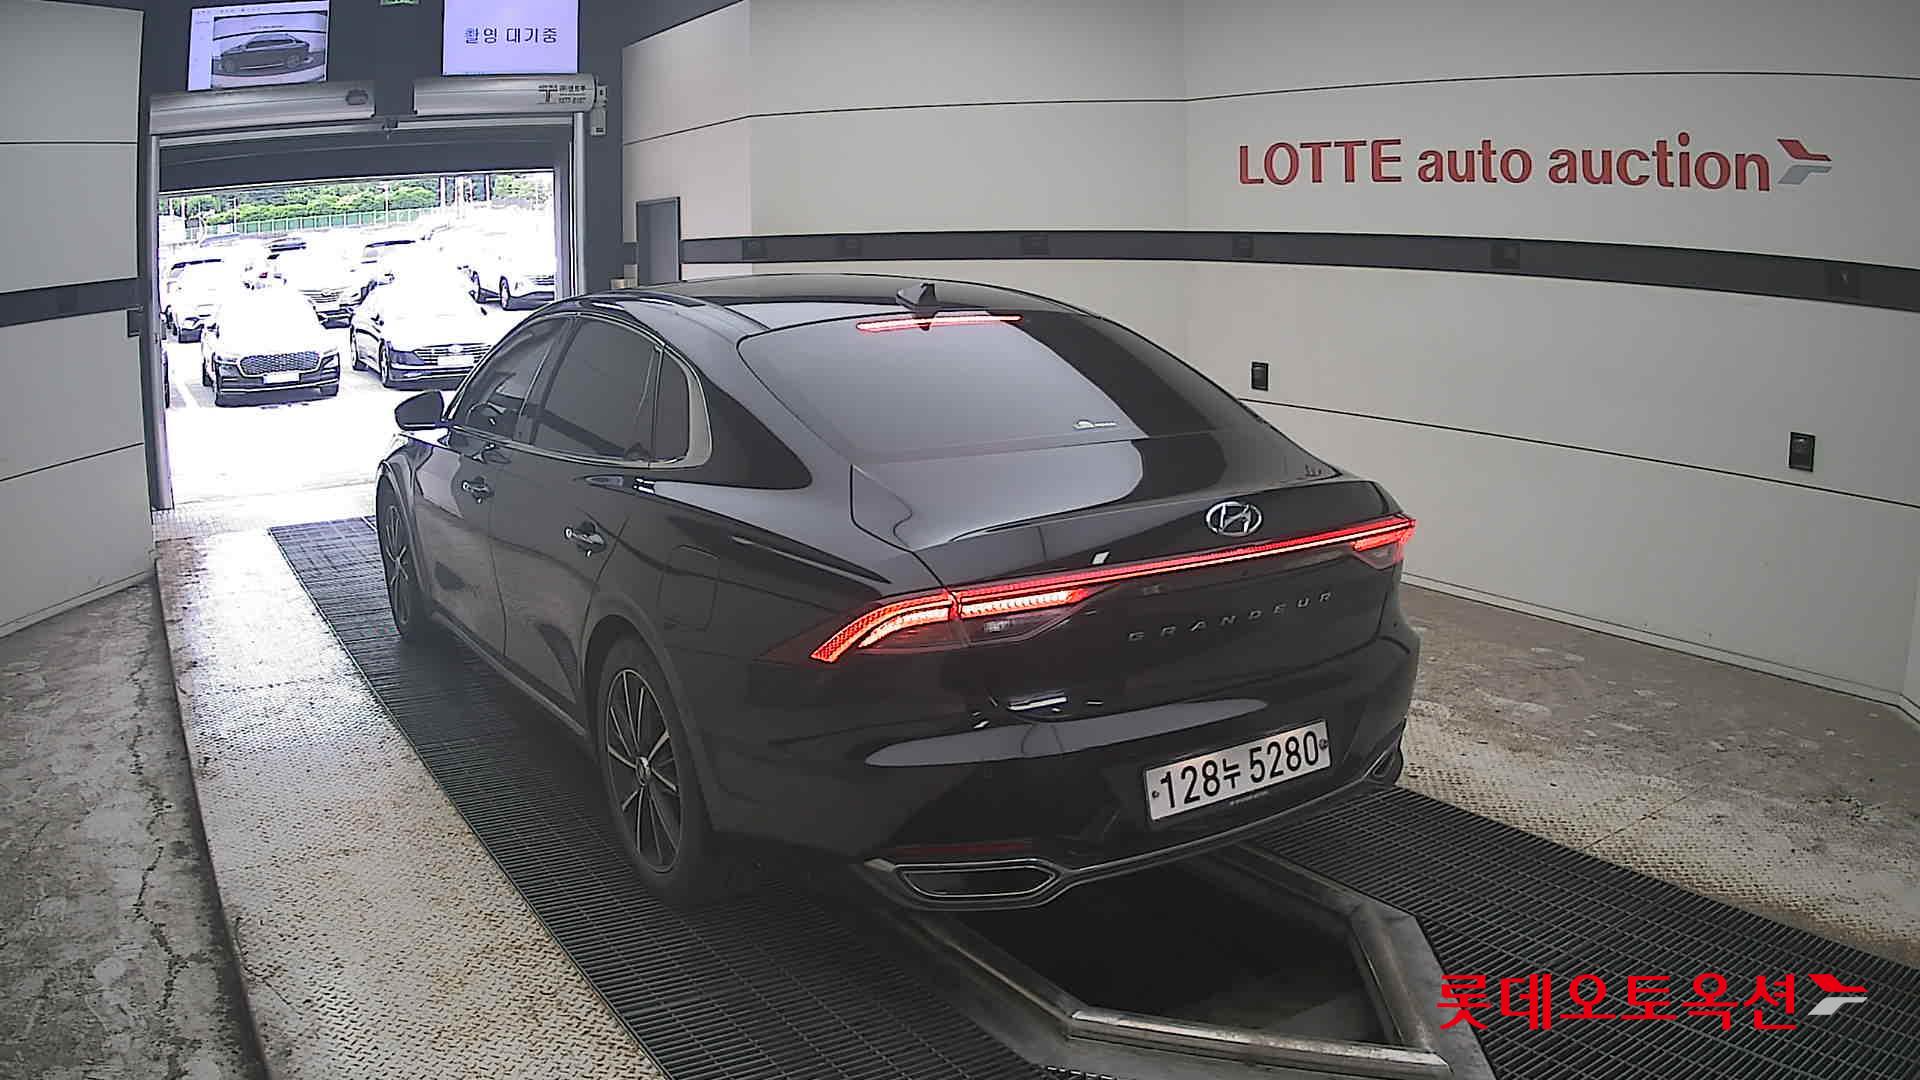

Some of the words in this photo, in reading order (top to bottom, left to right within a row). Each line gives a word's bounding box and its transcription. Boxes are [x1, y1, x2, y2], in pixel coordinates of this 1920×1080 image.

[506, 27, 557, 44] 대기중
[1239, 138, 1402, 185] LOTTE
[1417, 139, 1533, 185] auto
[1548, 132, 1772, 192] auction
[1127, 591, 1333, 642] GRANDEUR
[1160, 757, 1241, 809] 128누
[1248, 730, 1319, 784] 5280
